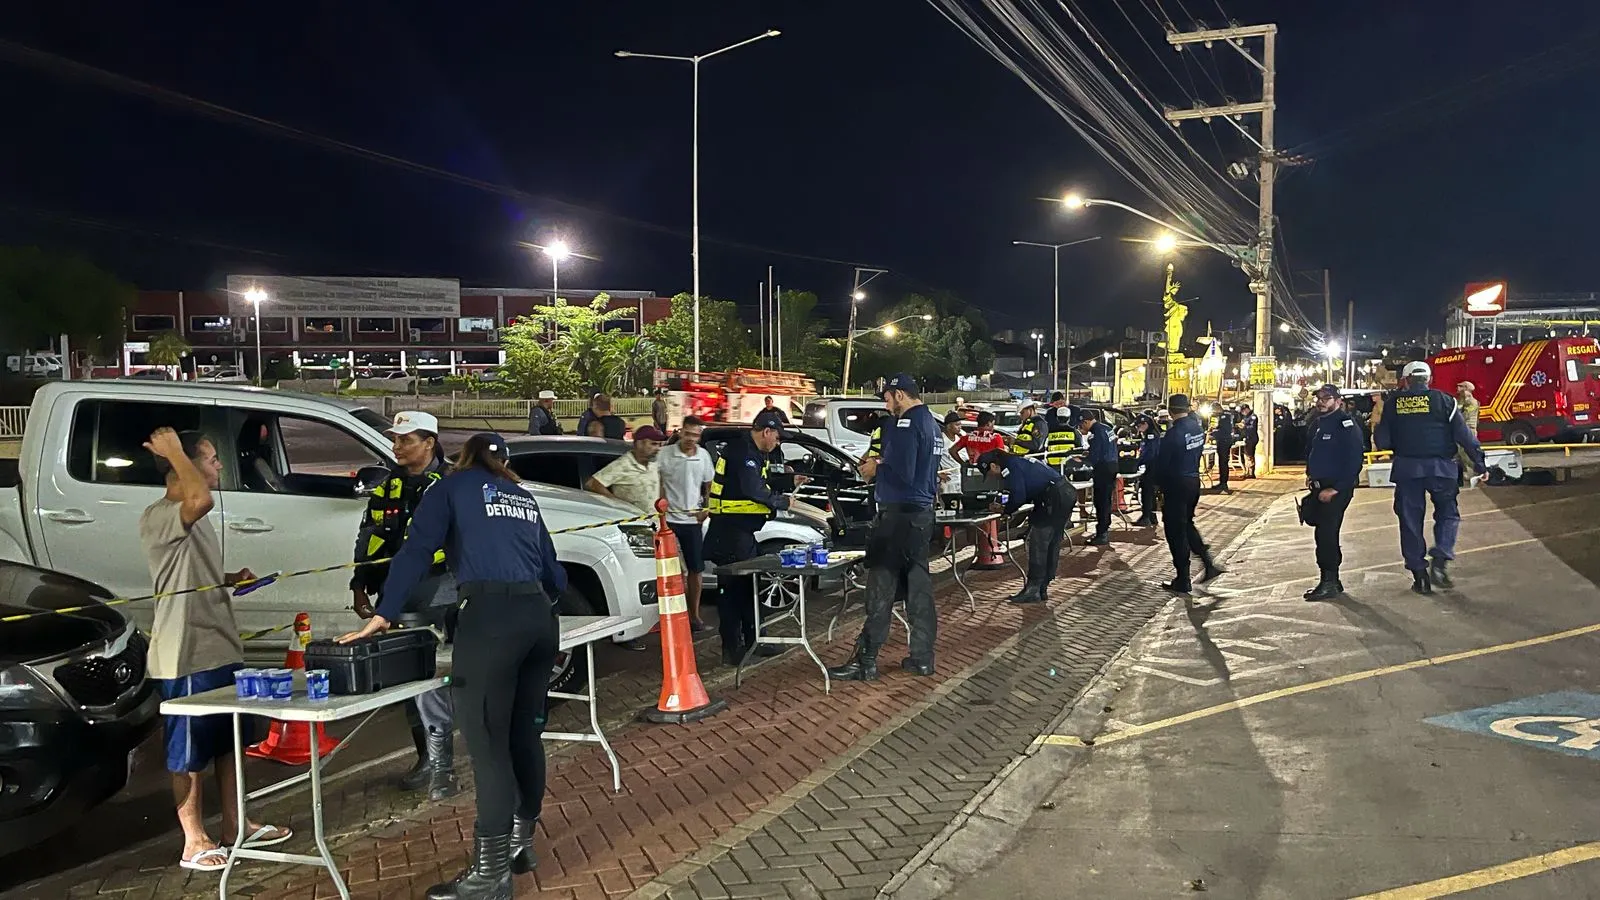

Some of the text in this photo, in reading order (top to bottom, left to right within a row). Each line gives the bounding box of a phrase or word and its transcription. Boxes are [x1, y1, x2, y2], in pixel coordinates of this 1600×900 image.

[1567, 345, 1597, 355] RESGATE
[1434, 353, 1466, 364] RESGATE
[1396, 395, 1430, 404] GUARDA
[1533, 400, 1547, 410] 193
[497, 491, 536, 505] Fiscalização
[950, 500, 958, 509] 3
[485, 503, 538, 523] DETRAN MT
